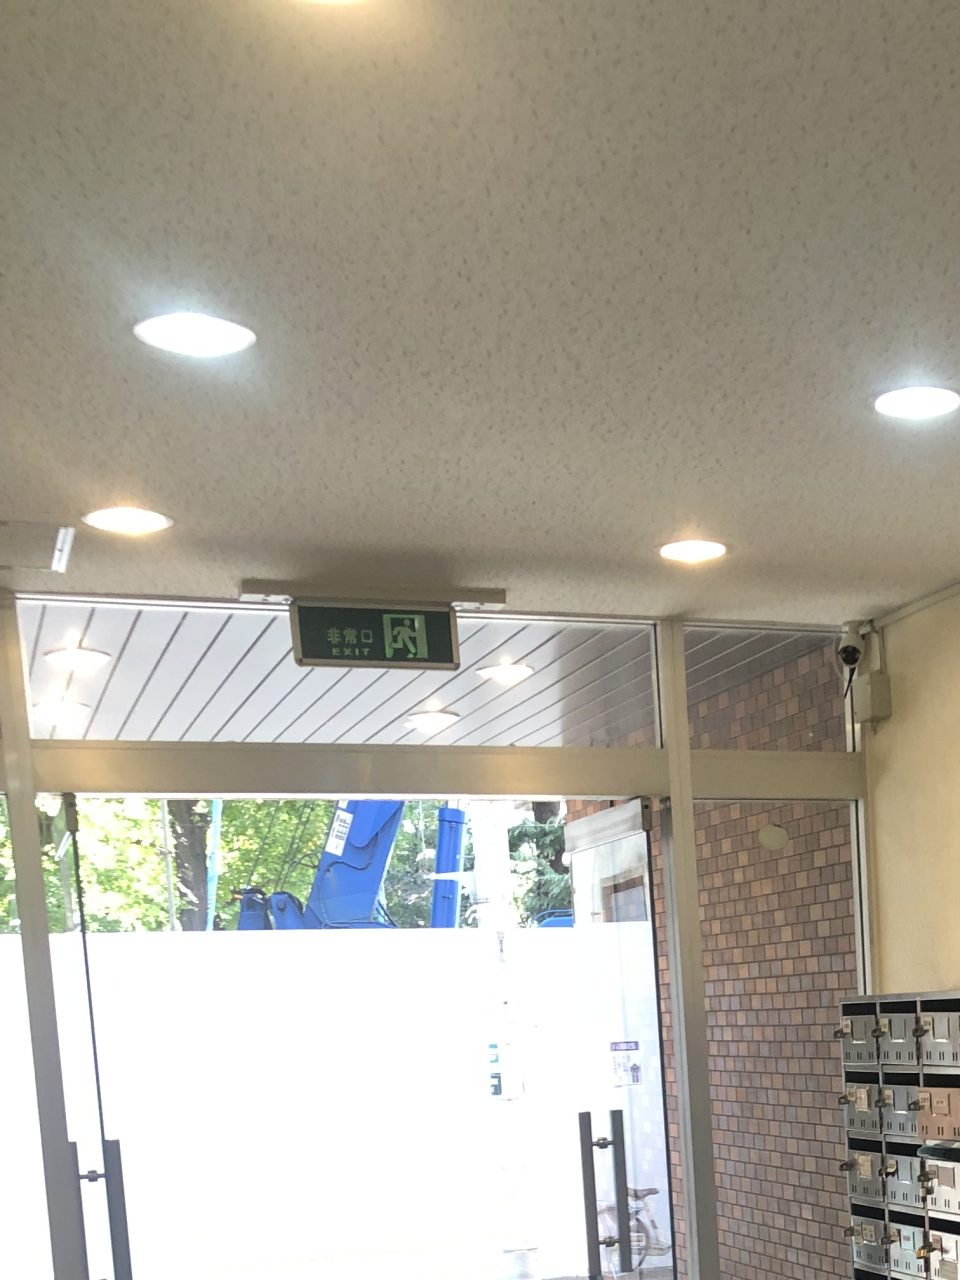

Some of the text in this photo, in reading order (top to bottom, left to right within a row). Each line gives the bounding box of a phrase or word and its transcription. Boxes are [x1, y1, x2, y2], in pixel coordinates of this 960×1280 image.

[327, 626, 373, 644] 非常口
[332, 647, 370, 656] EXIT
